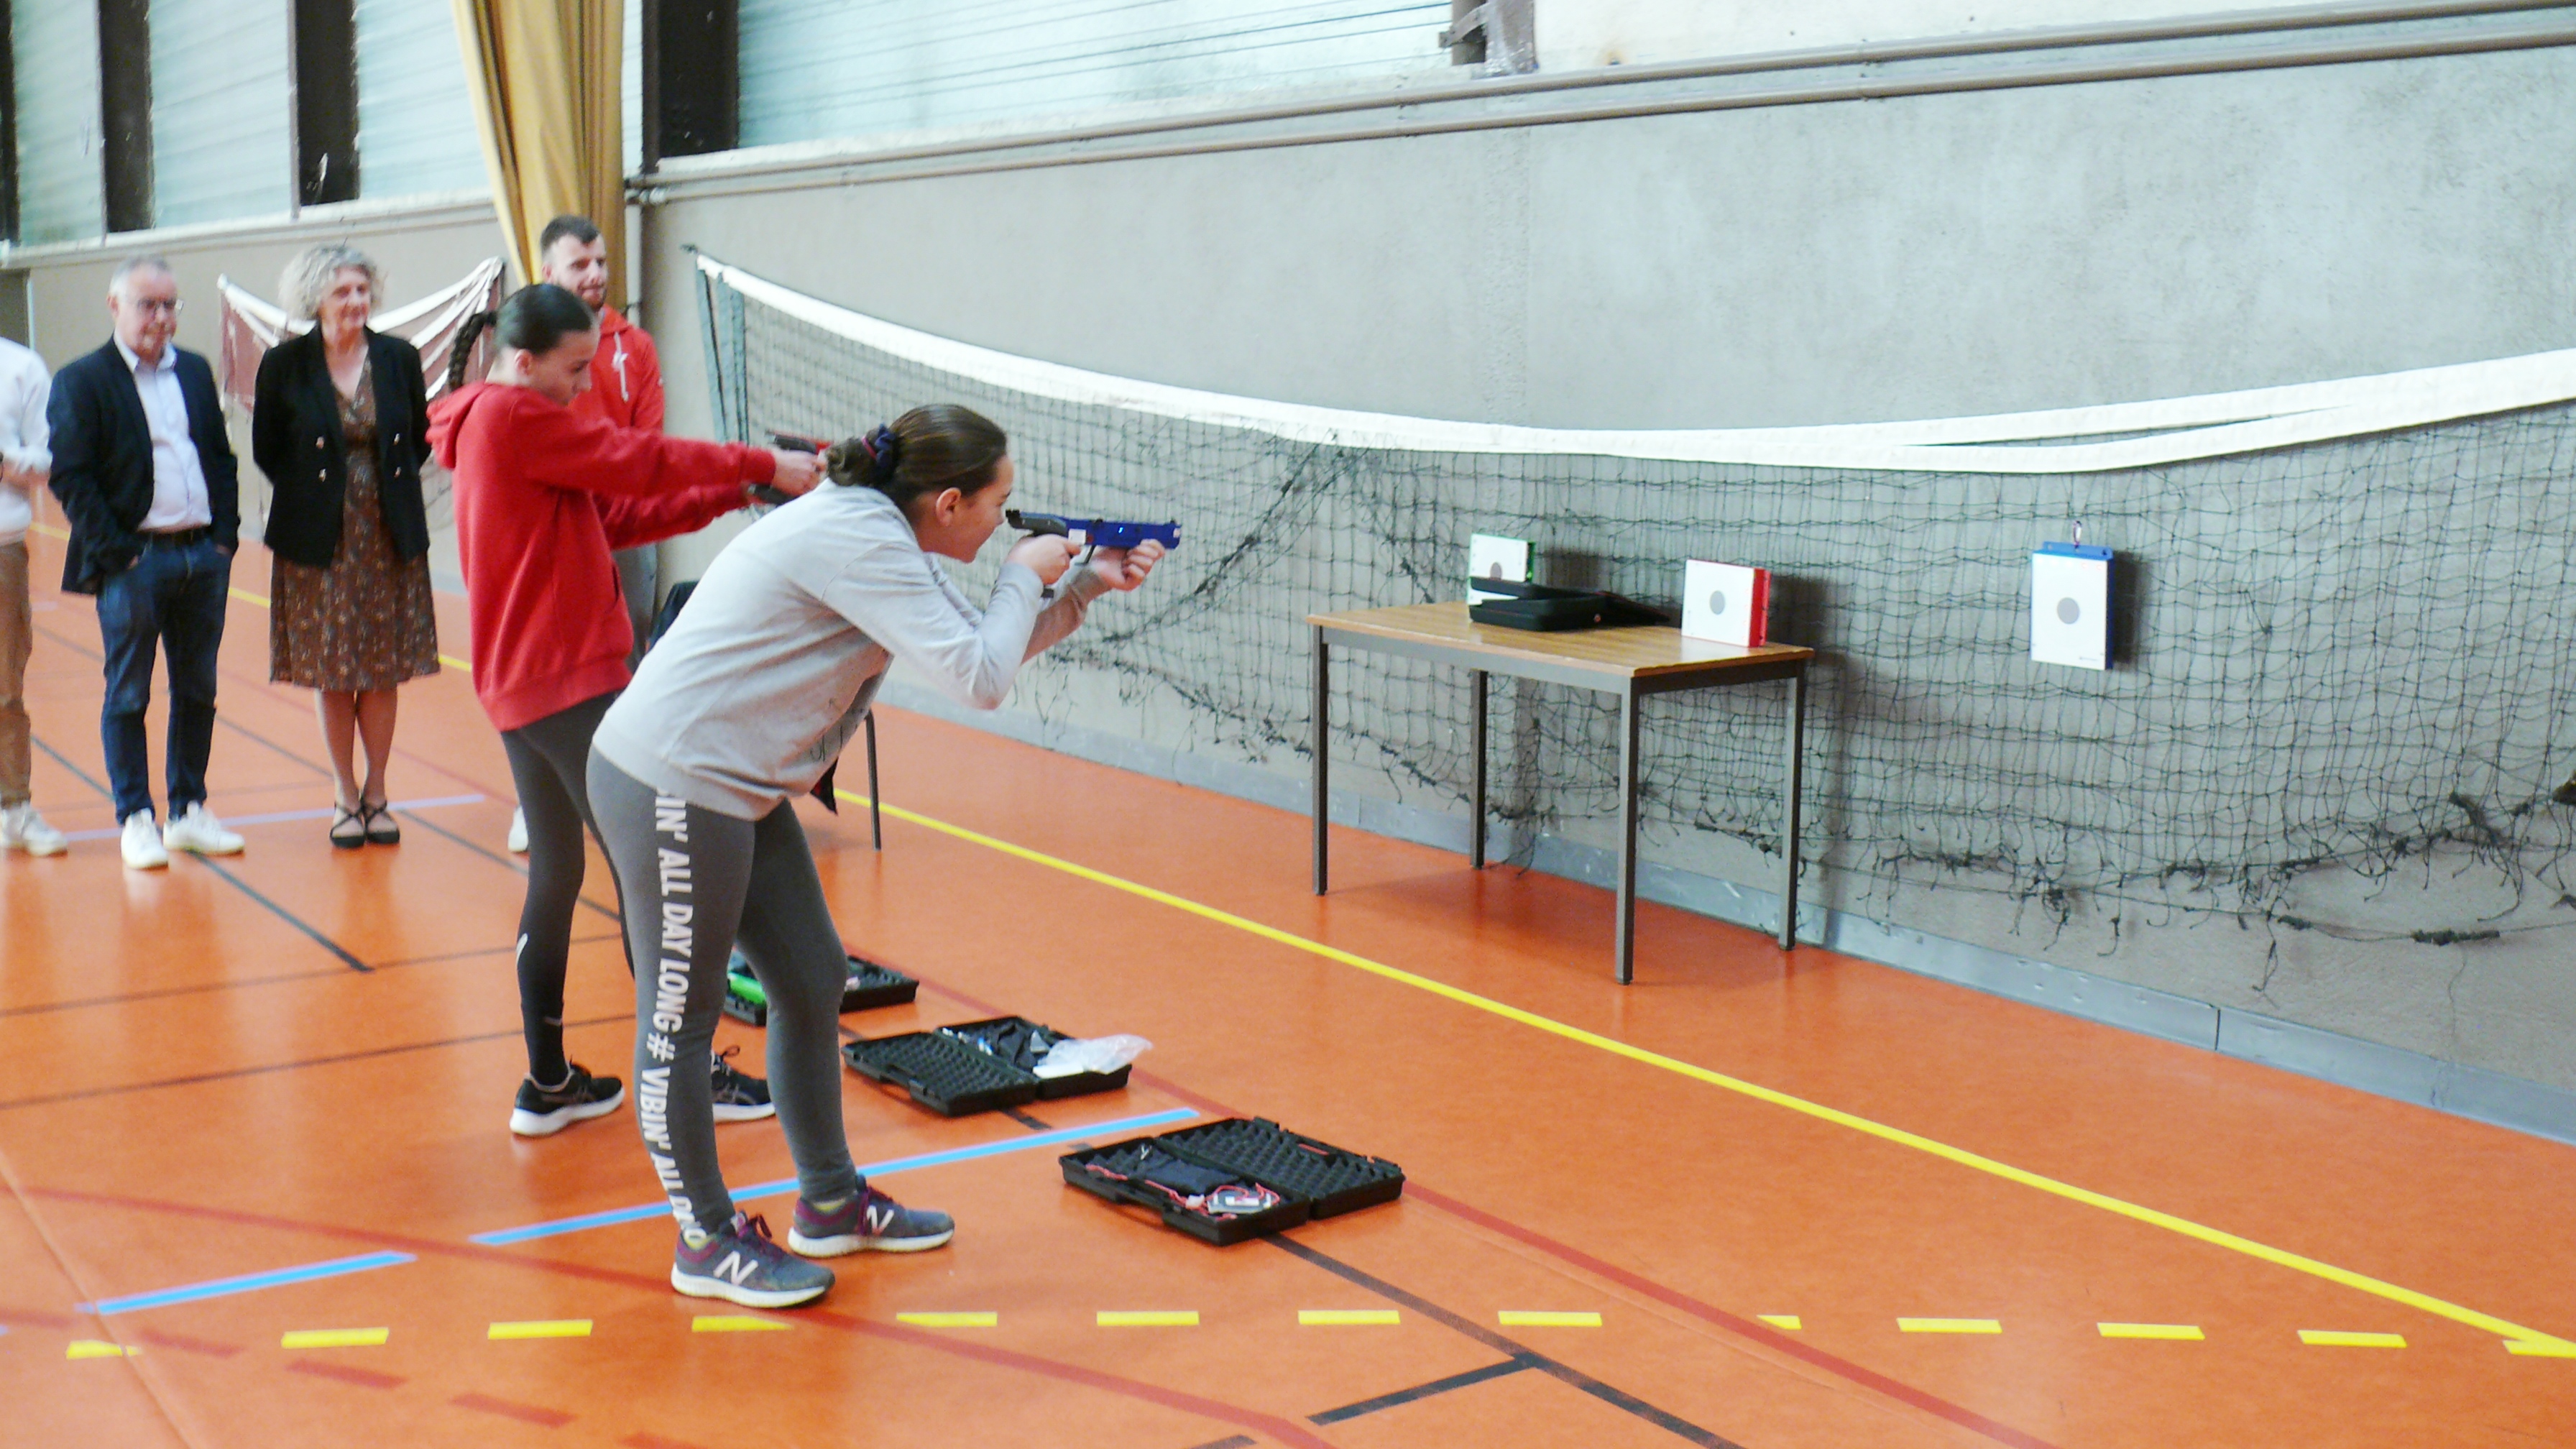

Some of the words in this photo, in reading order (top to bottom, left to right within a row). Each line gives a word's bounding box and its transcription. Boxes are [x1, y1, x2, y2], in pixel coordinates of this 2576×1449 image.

[655, 788, 689, 844] IN'
[658, 847, 692, 896] ALL
[662, 902, 693, 958] DAY
[653, 957, 690, 1033] LONG
[647, 1032, 676, 1063] #
[640, 1067, 671, 1150] VIBIN'
[713, 1251, 759, 1286] N
